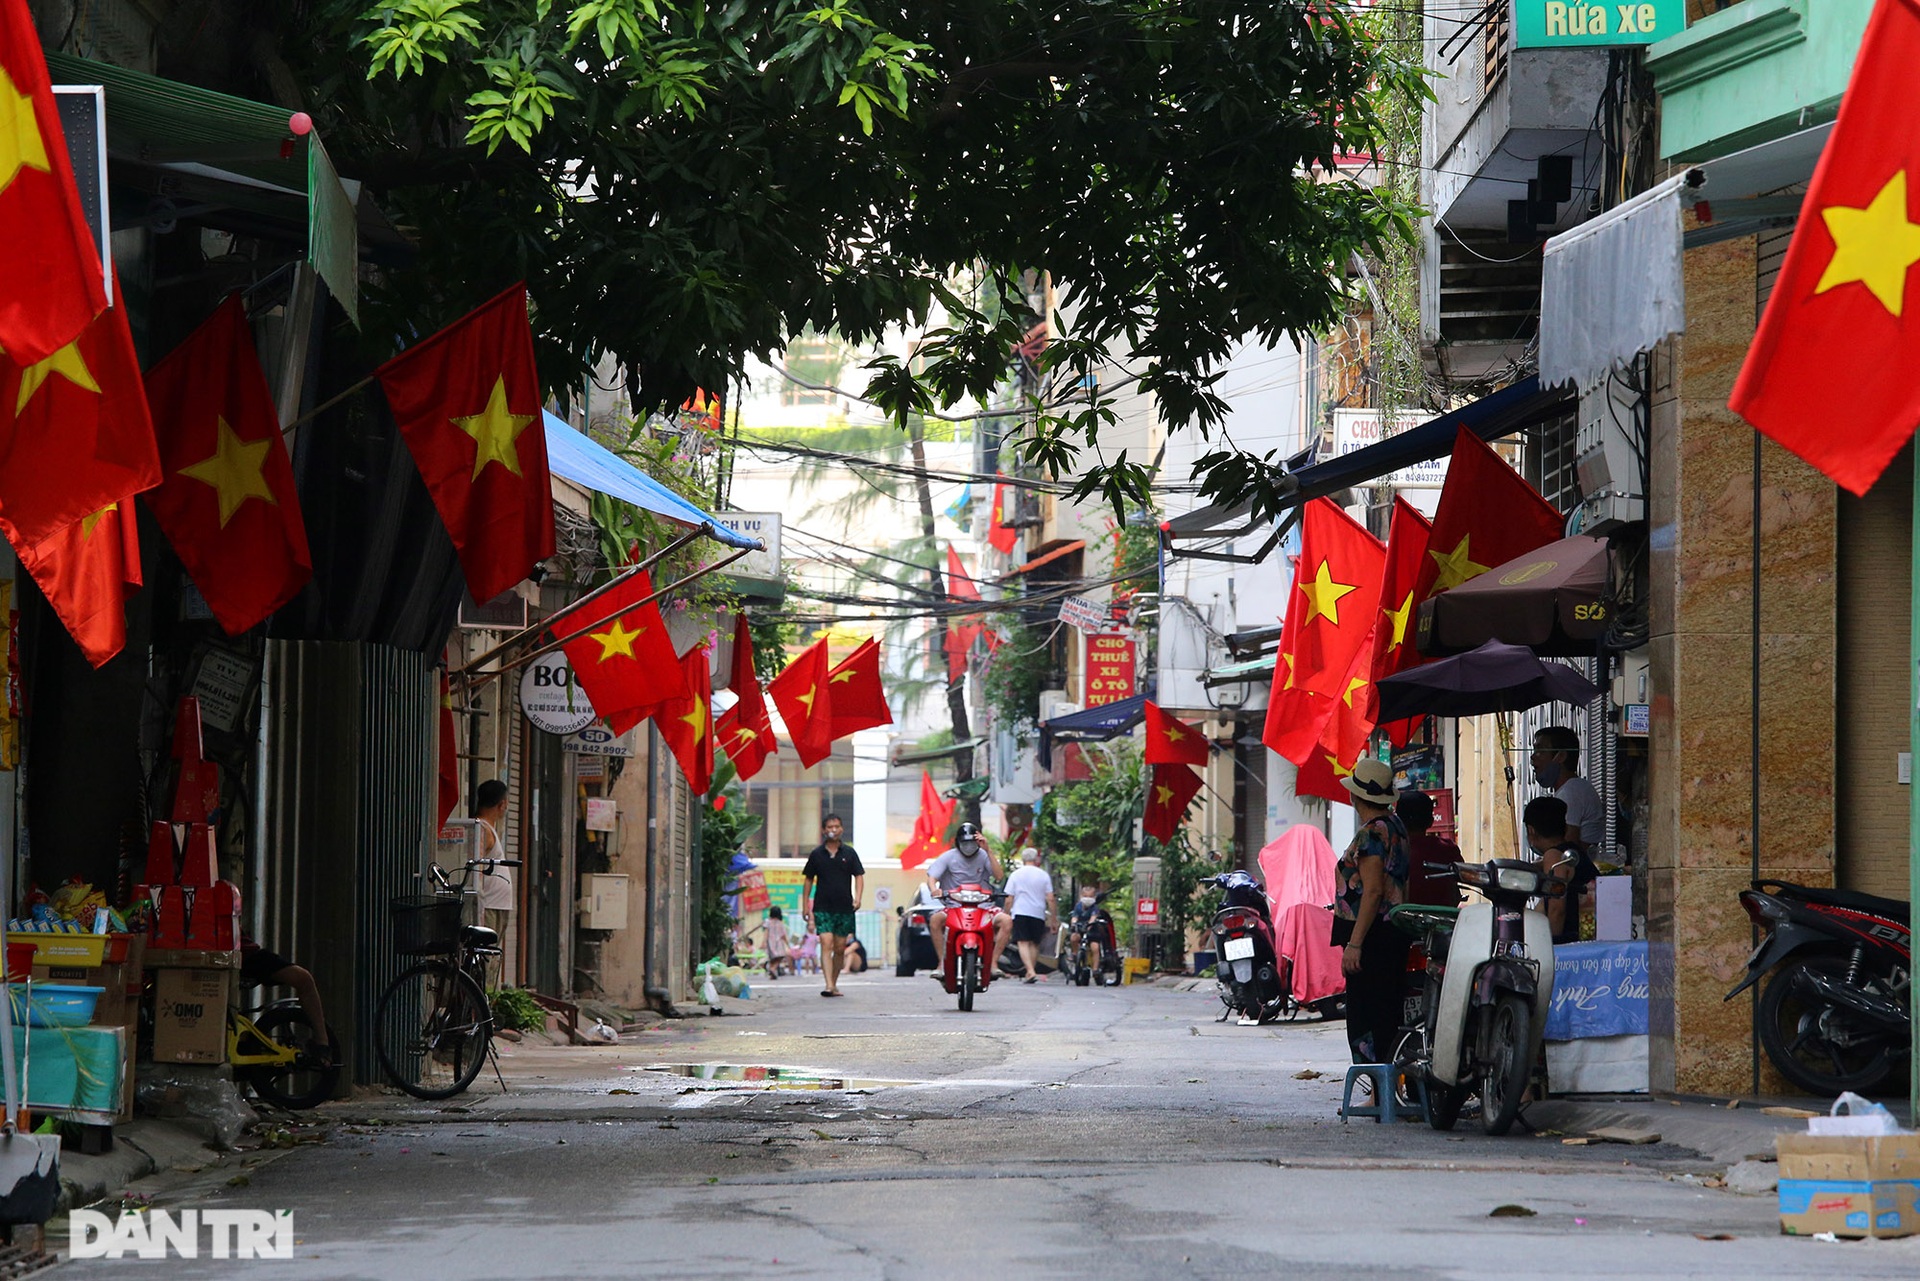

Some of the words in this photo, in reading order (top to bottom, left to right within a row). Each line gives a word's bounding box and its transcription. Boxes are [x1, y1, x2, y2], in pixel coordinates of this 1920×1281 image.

[1617, 3, 1656, 34] xe
[1351, 420, 1379, 439] CHO
[743, 520, 761, 534] VỤ
[1096, 638, 1126, 649] CHO
[1090, 651, 1130, 662] THUÊ
[1100, 666, 1120, 676] XE
[1091, 678, 1103, 690] Ô
[1106, 678, 1128, 690] TÔ
[585, 732, 605, 742] 50
[582, 744, 600, 753] 642
[603, 746, 627, 755] 9902
[174, 1003, 204, 1018] OMO
